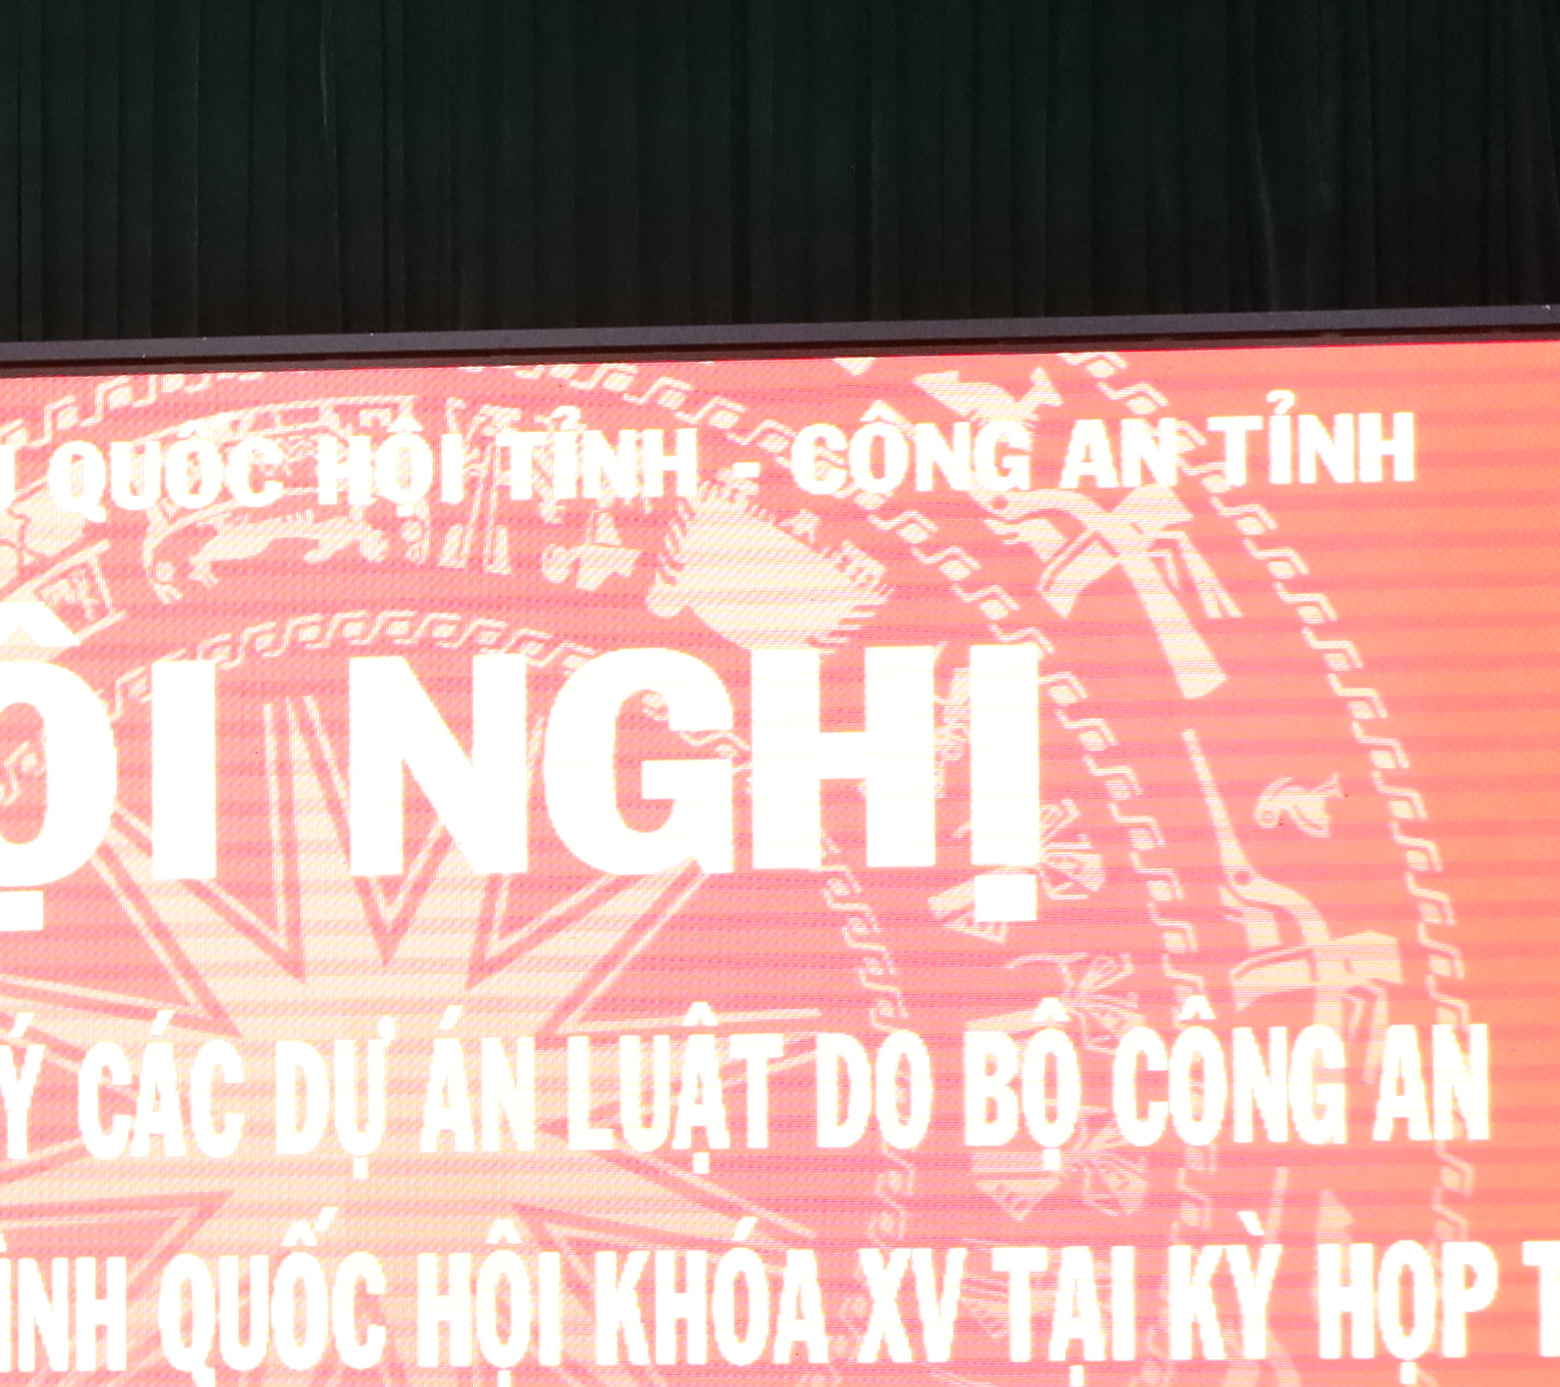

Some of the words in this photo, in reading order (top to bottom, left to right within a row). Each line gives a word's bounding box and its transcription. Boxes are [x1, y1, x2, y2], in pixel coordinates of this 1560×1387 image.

[47, 412, 283, 523] QUỐC
[316, 417, 466, 517] HỘI
[495, 406, 697, 500] TỈNH
[732, 463, 759, 478] -
[790, 407, 1030, 495] CÔNG
[1060, 418, 1180, 488] AN
[1208, 391, 1413, 487] TỈNH
[348, 645, 1041, 922] NGHỊ
[78, 1010, 245, 1161] CÁC
[275, 1016, 396, 1180] DỰ
[420, 1006, 536, 1153] ÁN
[567, 1002, 784, 1174] LUẬT
[816, 1032, 932, 1149] DO
[964, 998, 1081, 1171] BỘ
[1113, 996, 1345, 1147] CÔNG
[1373, 1024, 1488, 1141] AN
[595, 1217, 828, 1366] KHÓA
[858, 1248, 966, 1363] XV
[992, 1246, 1135, 1387] TẠI
[1167, 1211, 1281, 1360] KỲ
[1318, 1240, 1497, 1385] HỌP
